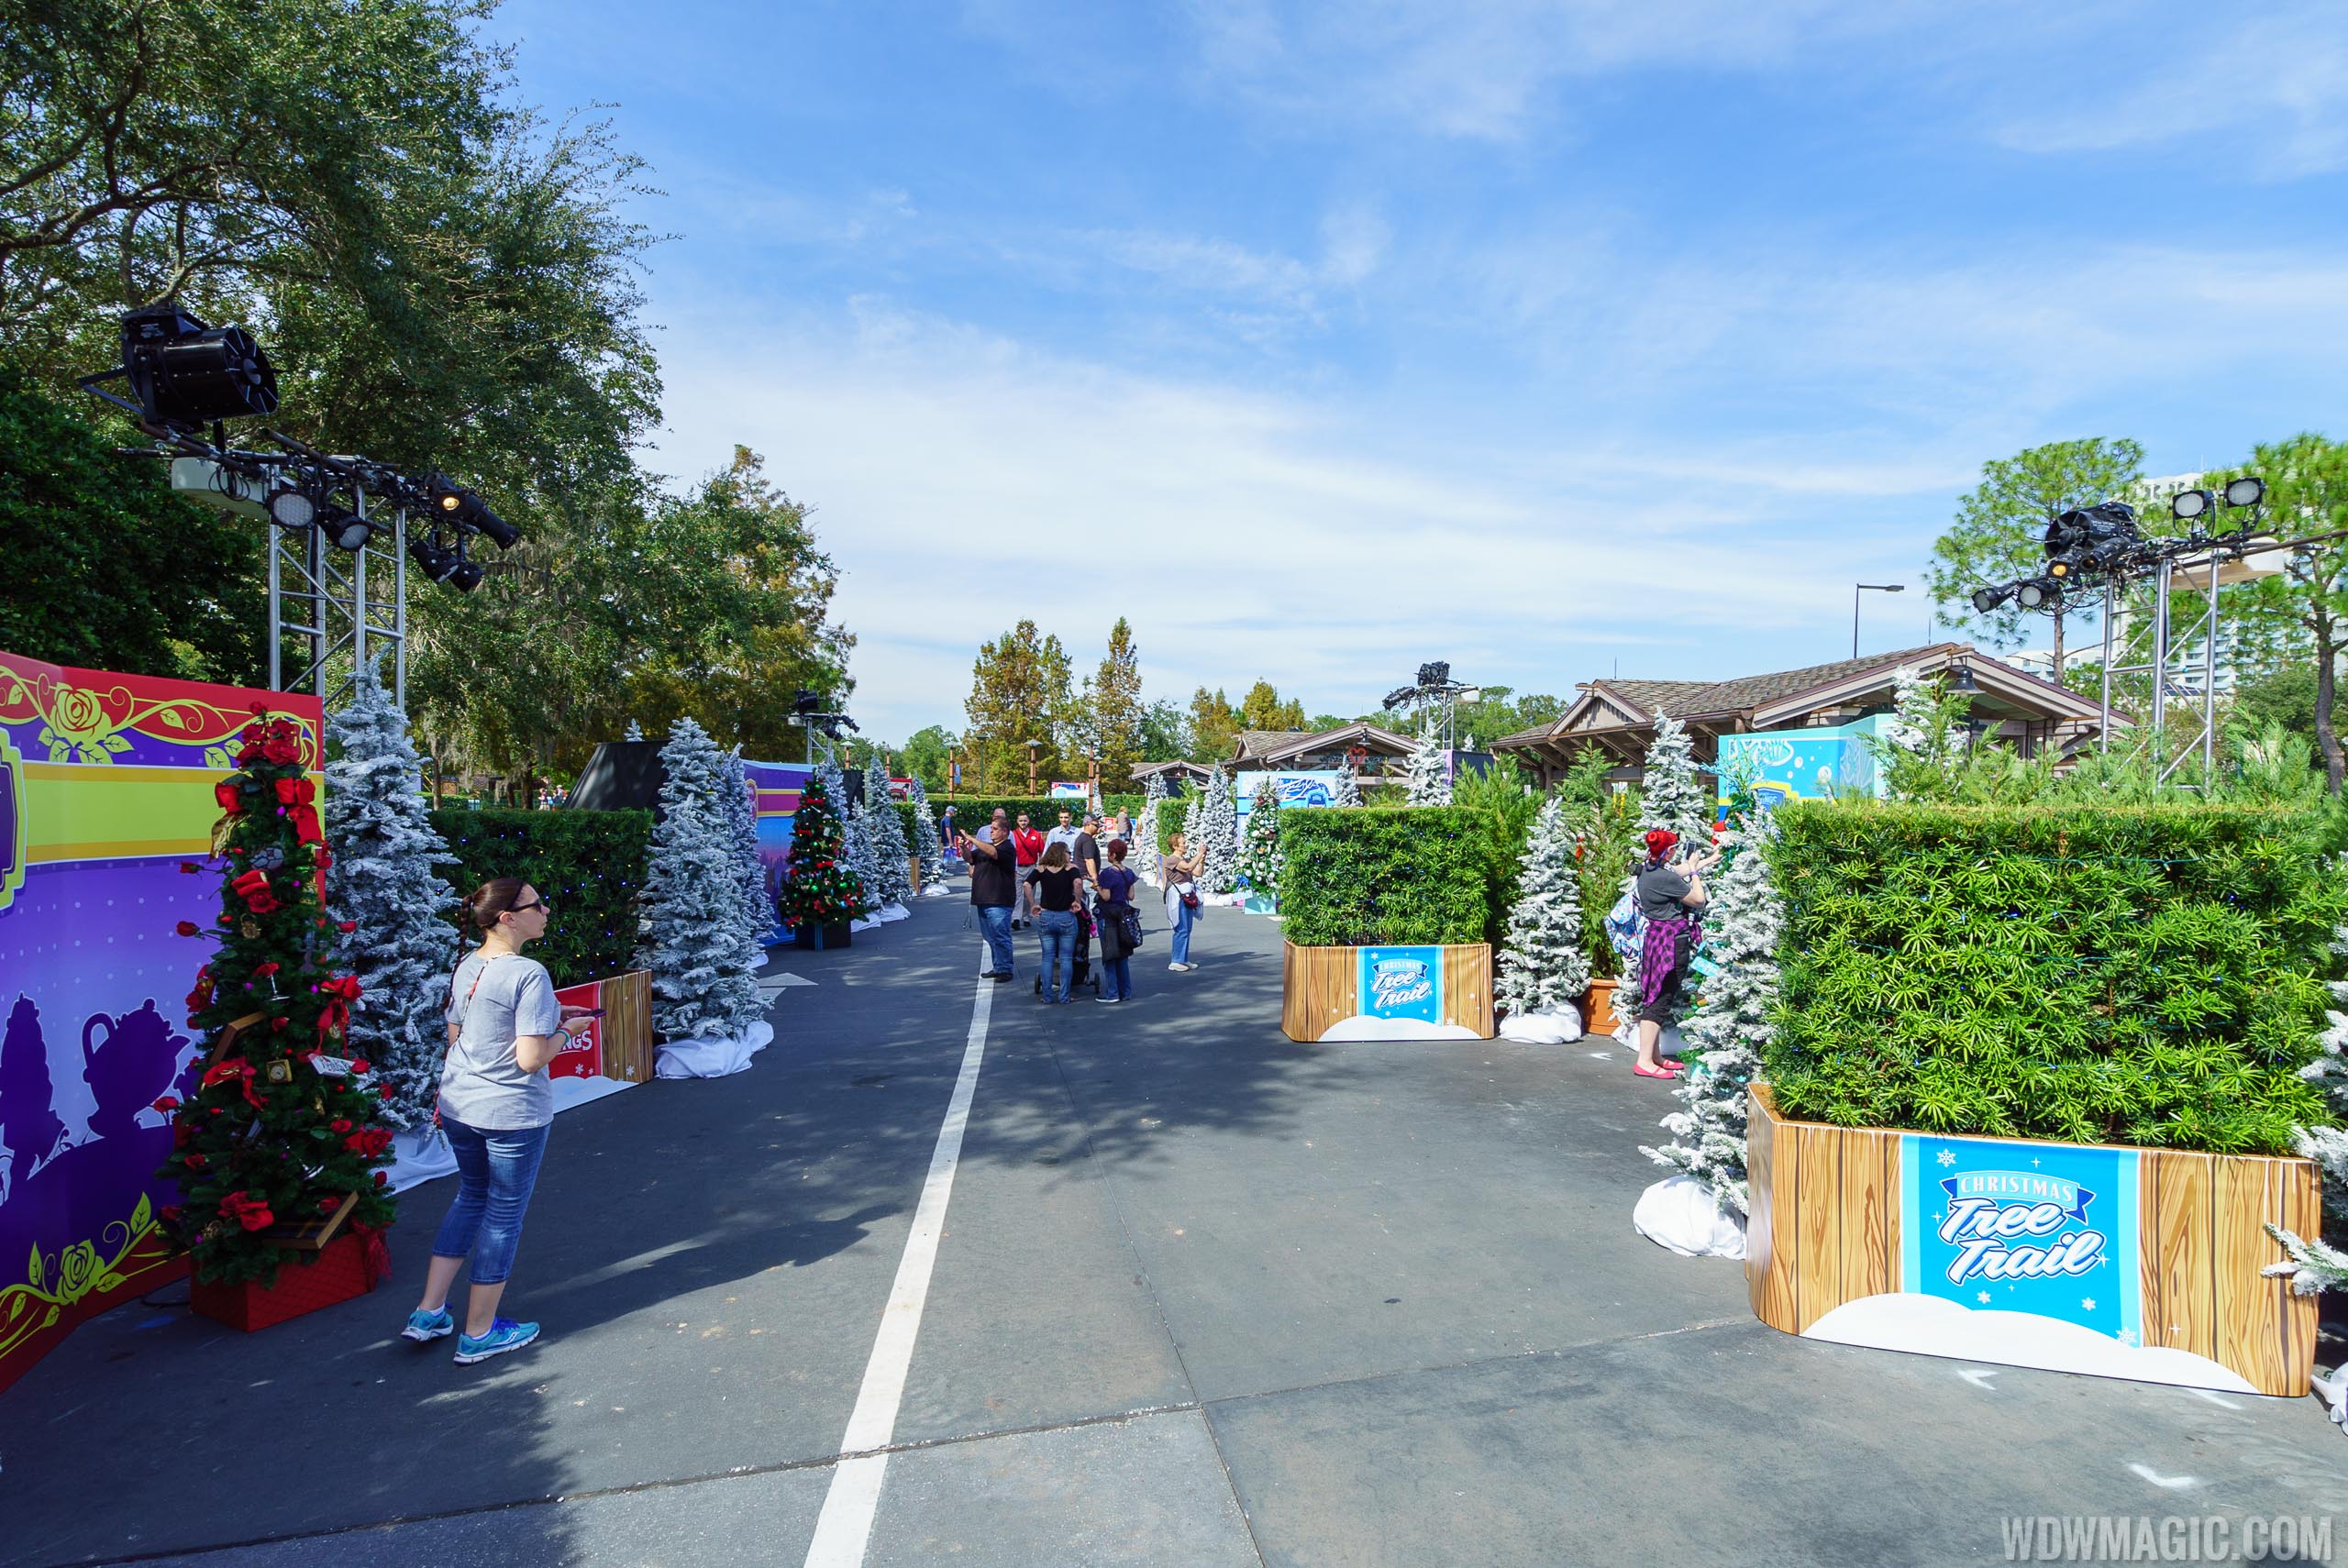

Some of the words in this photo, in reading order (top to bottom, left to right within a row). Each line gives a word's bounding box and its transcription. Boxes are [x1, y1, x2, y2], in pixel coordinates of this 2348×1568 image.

[1372, 971, 1417, 992] Tree
[1374, 981, 1431, 1010] Trail
[1960, 1176, 2073, 1202] CHRISTMAS
[1939, 1198, 2066, 1244] Tree
[1947, 1231, 2105, 1285] Trail
